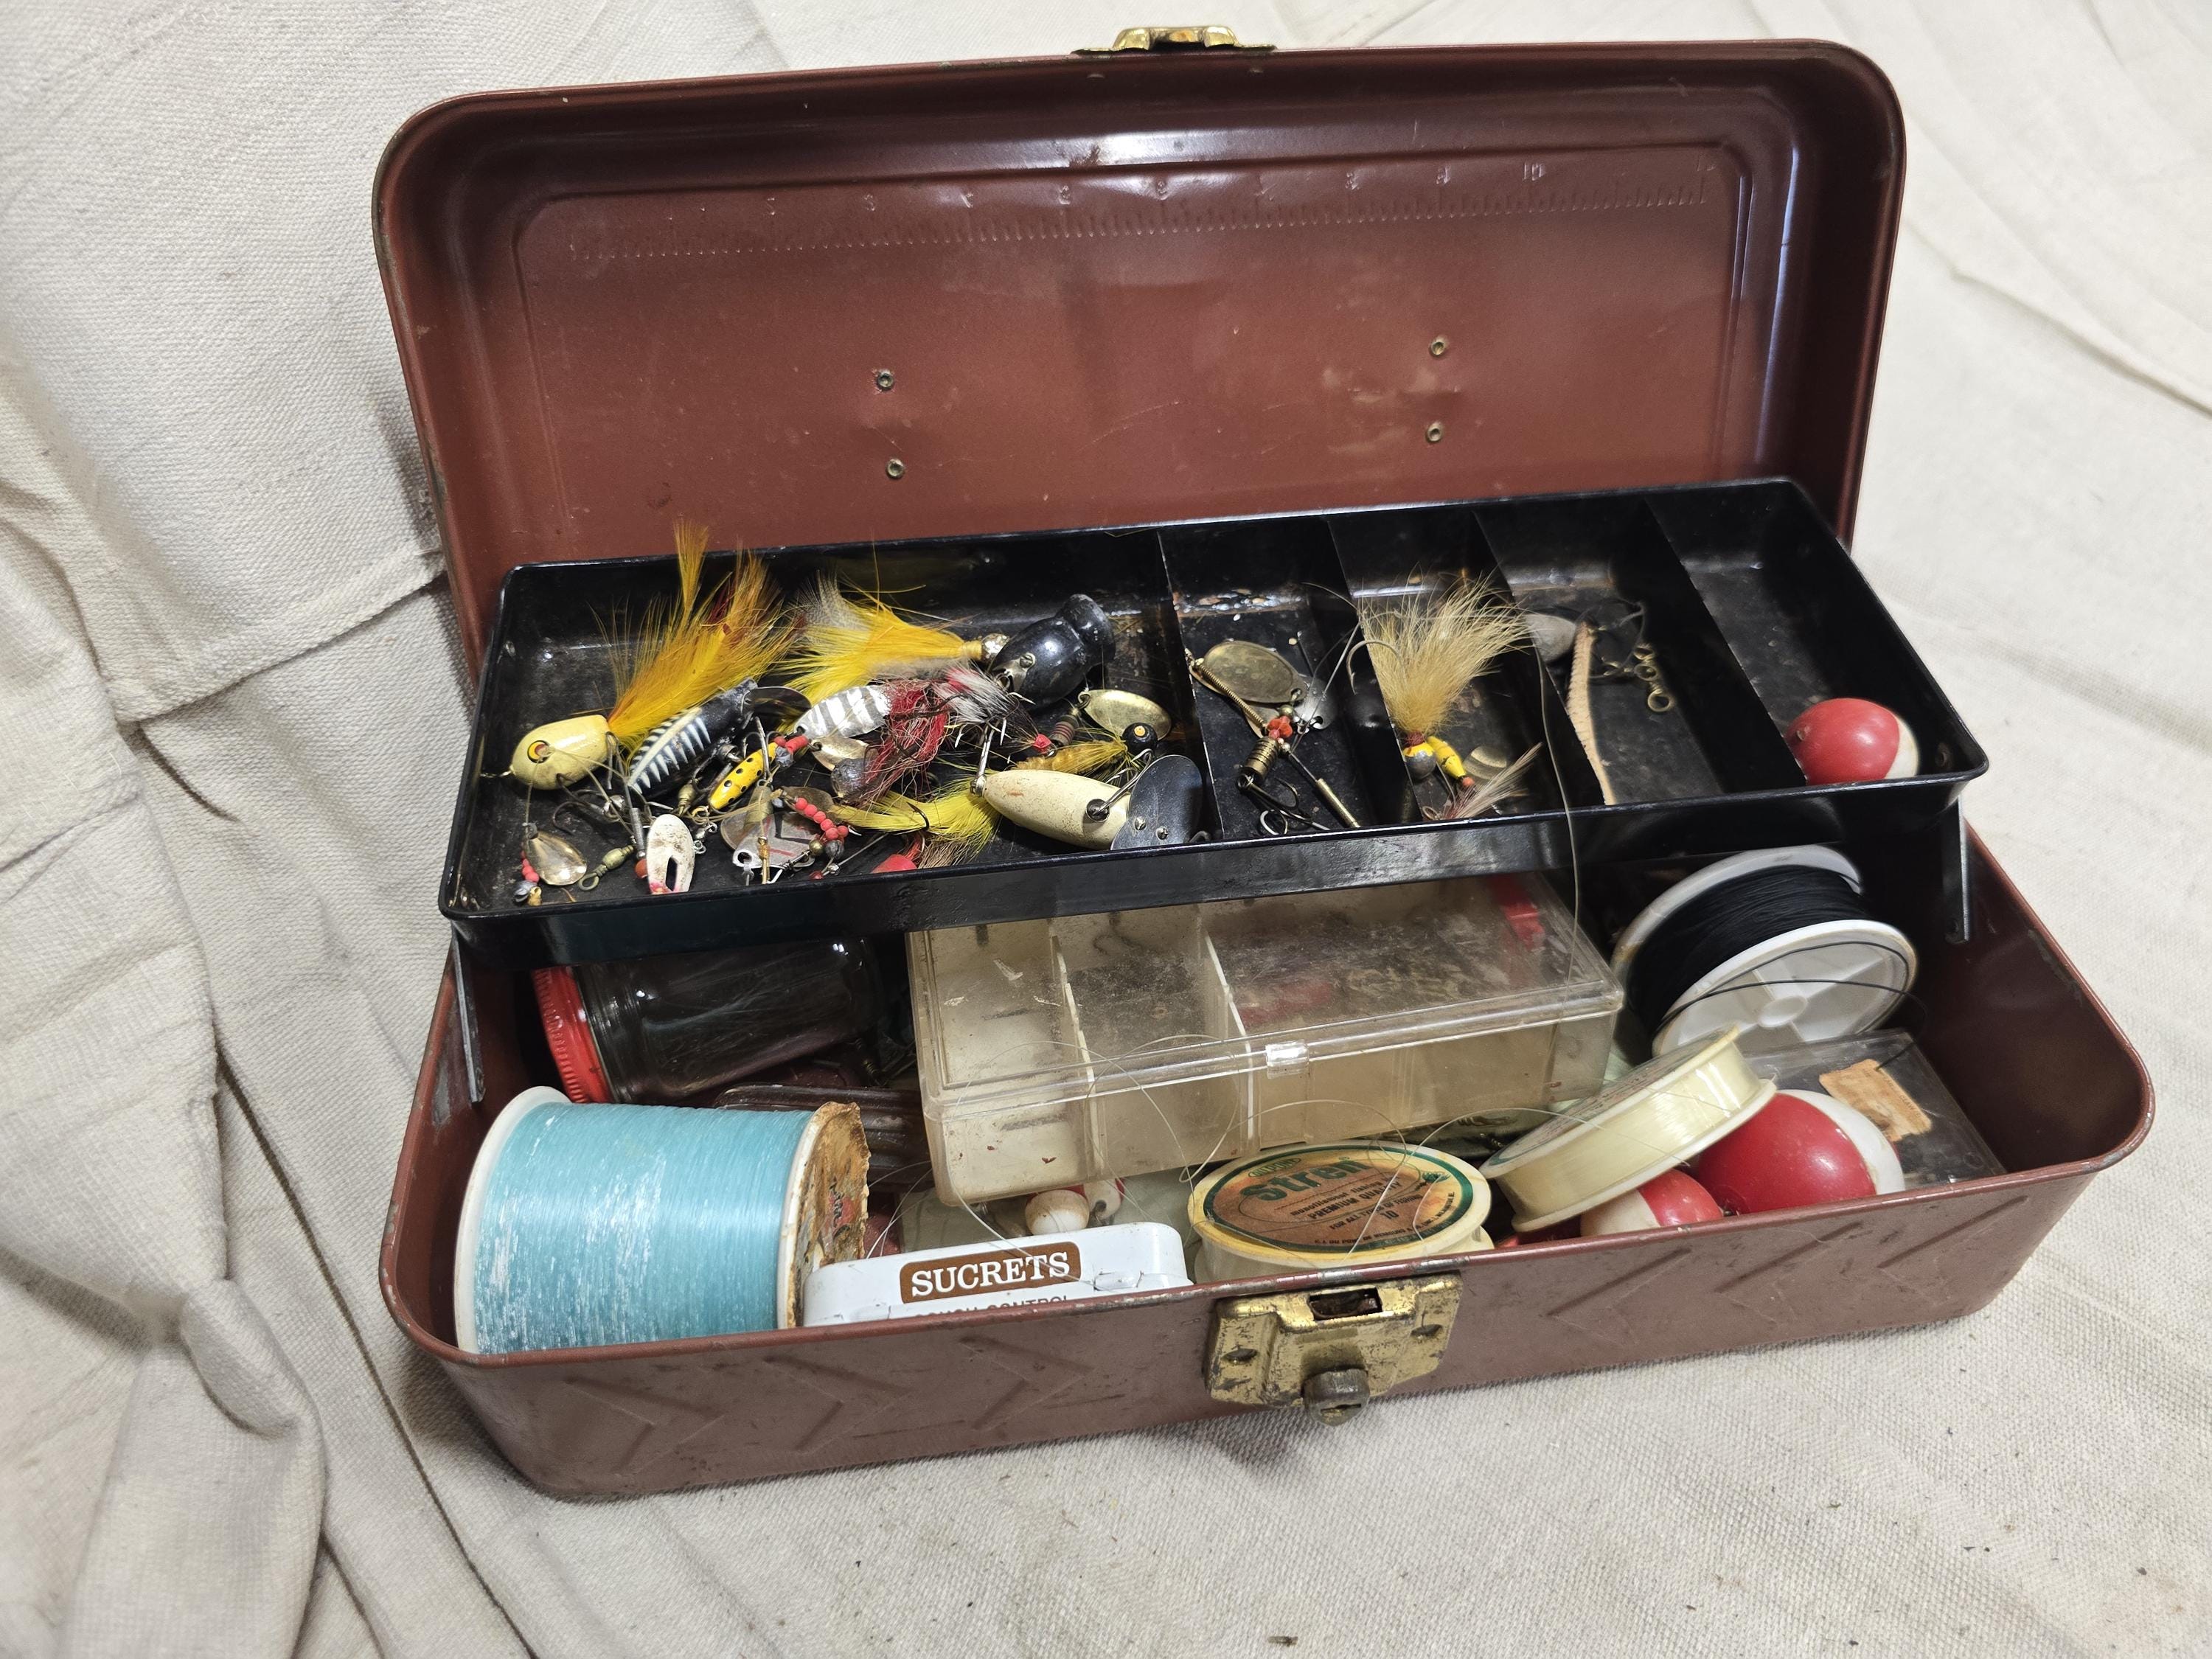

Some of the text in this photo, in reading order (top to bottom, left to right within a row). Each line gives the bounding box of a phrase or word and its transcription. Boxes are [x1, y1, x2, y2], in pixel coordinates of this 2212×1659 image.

[1522, 161, 1546, 181] 10
[1308, 1181, 1402, 1219] PREMIUM QUALITY
[1329, 1220, 1346, 1230] FOR
[1346, 1214, 1361, 1223] ALL
[1380, 1210, 1399, 1220] 10
[911, 1251, 1071, 1298] SUCRETS
